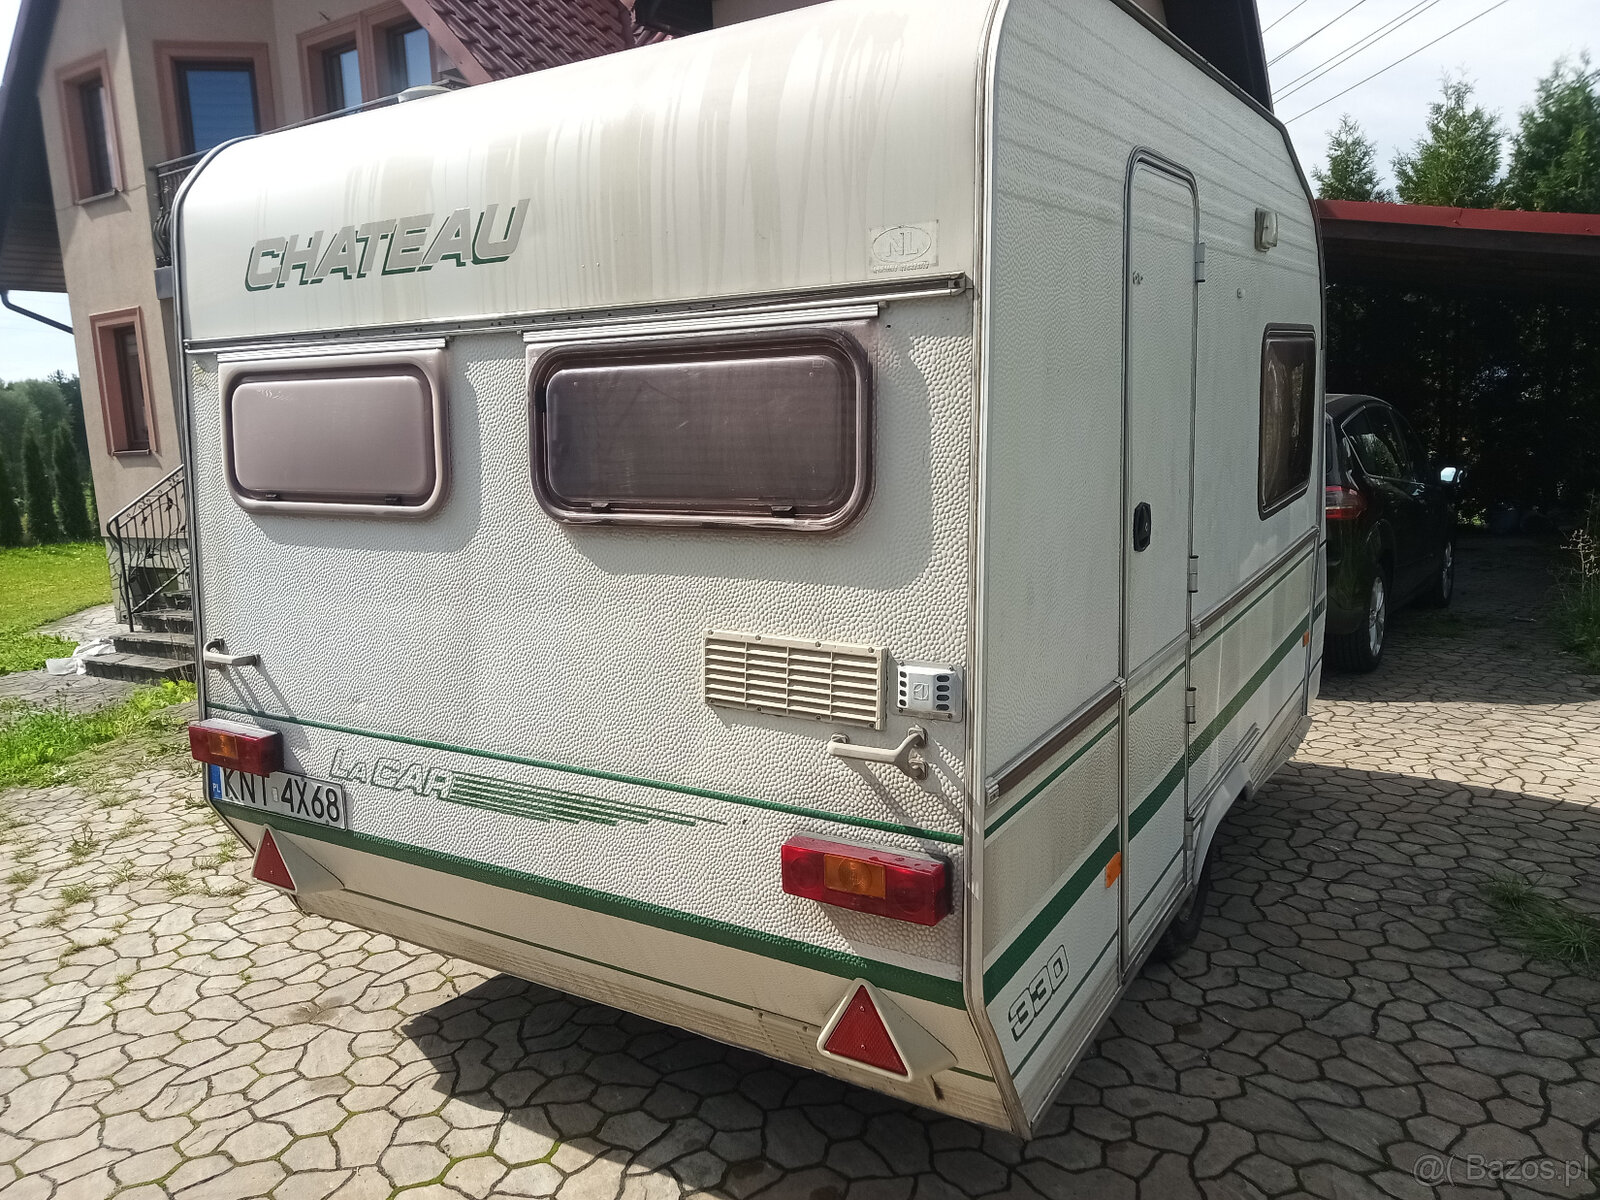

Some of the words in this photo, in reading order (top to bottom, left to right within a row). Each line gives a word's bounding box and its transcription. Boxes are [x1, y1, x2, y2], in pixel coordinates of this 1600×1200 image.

[245, 198, 531, 292] CHATEAU
[886, 231, 919, 257] NL
[212, 782, 221, 793] PL
[222, 766, 267, 806] KNT
[280, 777, 340, 823] 4X68
[1008, 944, 1070, 1042] 330
